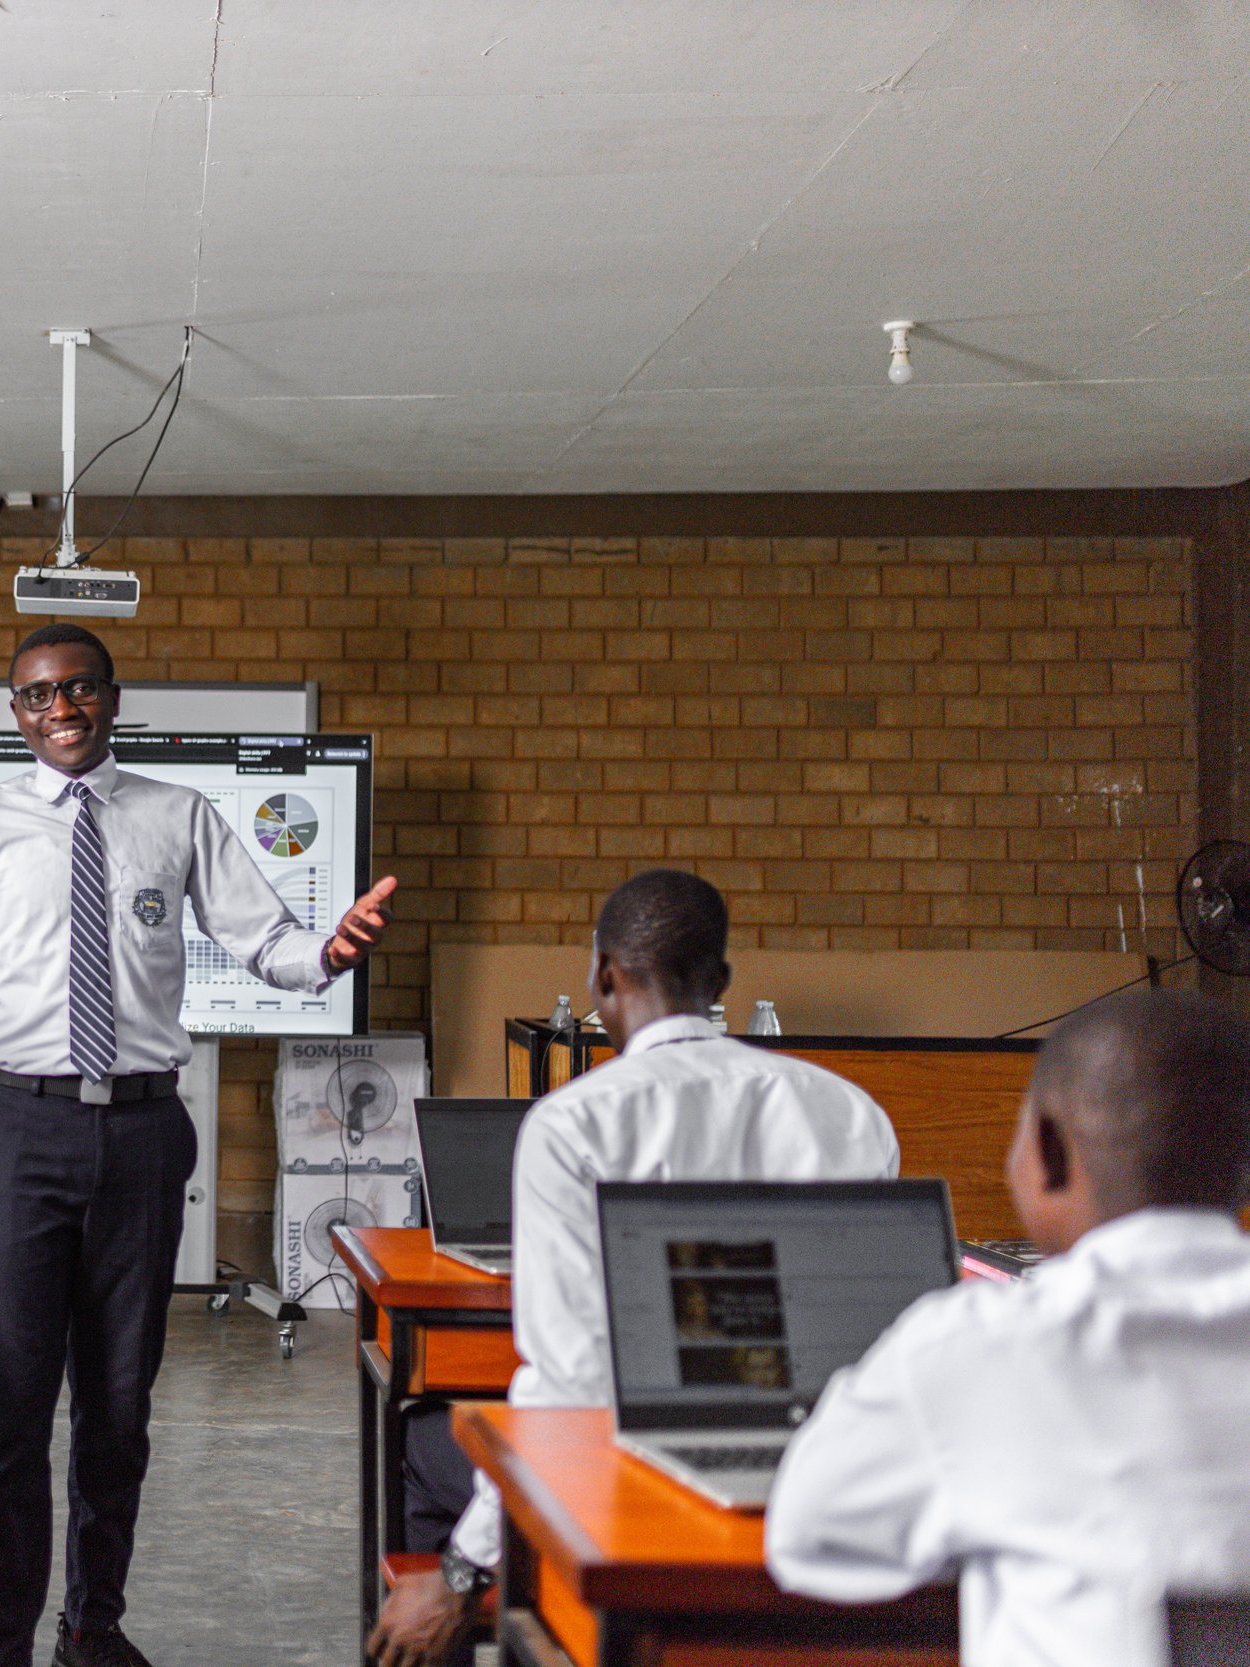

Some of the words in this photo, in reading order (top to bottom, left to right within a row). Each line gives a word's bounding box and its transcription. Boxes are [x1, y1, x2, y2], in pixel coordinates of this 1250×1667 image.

[202, 1022, 227, 1033] Your
[230, 1022, 255, 1034] Data
[292, 1043, 374, 1058] SONASHI
[288, 1221, 302, 1301] SONASHI
